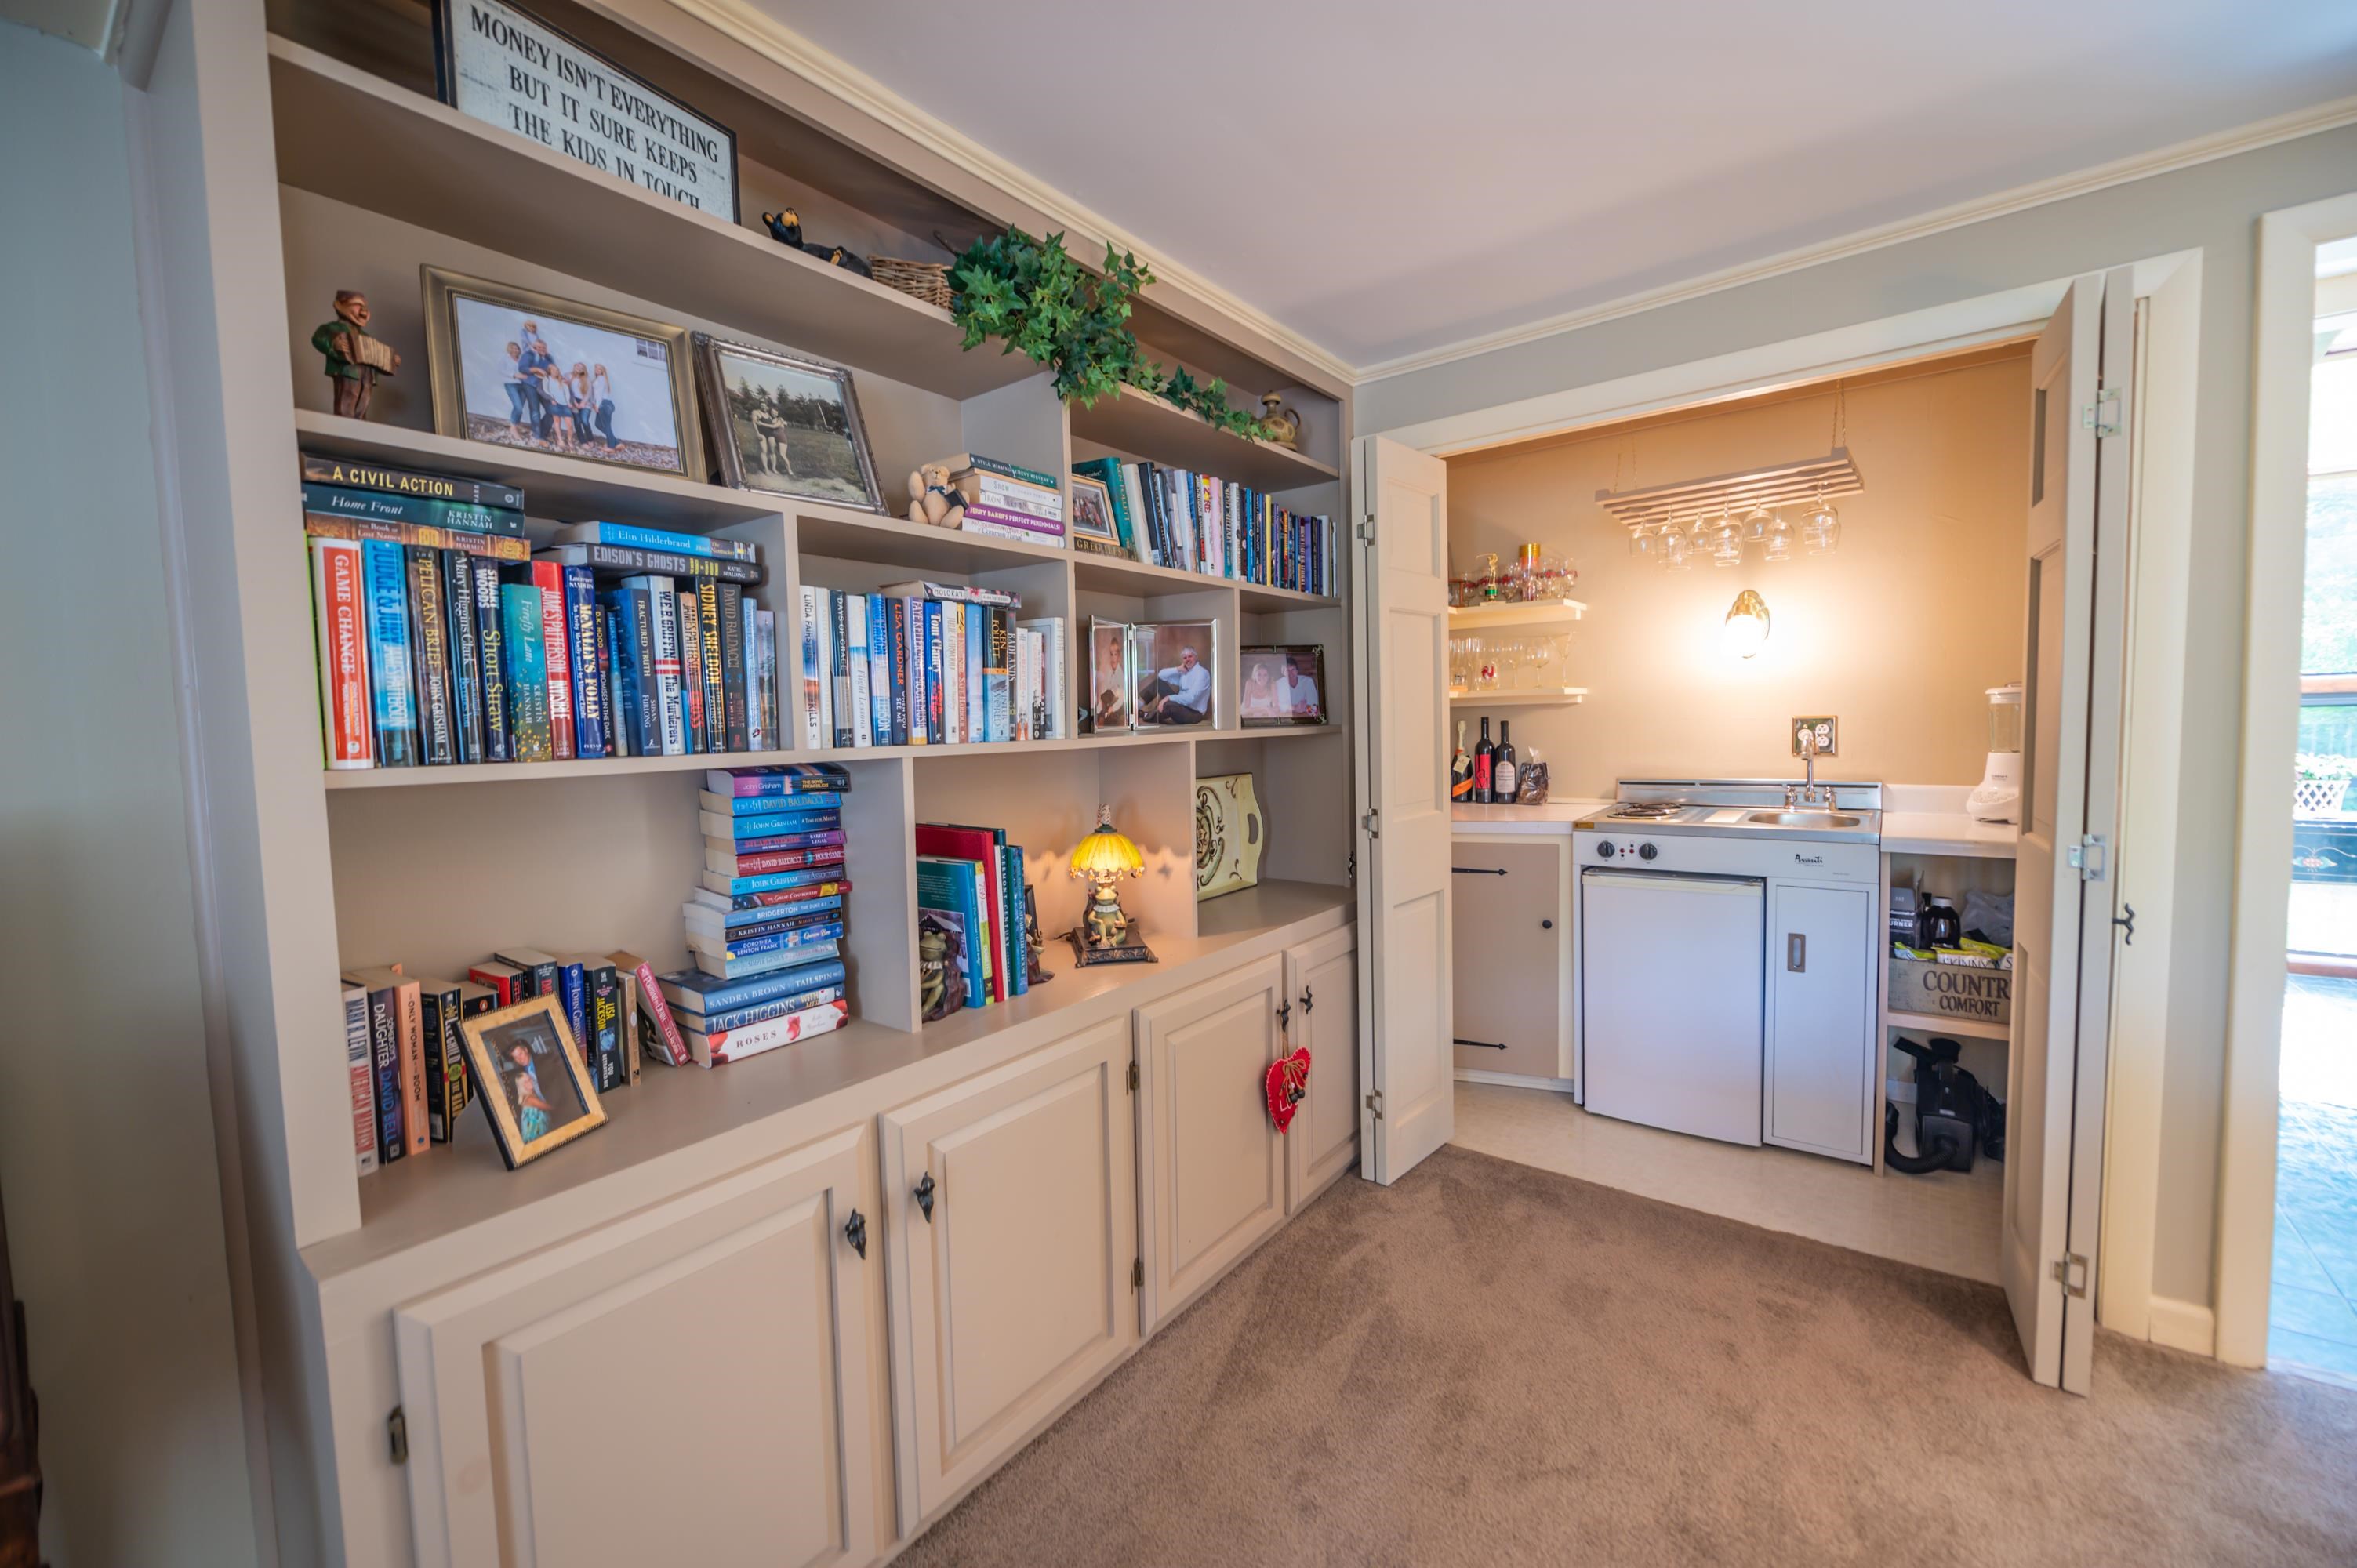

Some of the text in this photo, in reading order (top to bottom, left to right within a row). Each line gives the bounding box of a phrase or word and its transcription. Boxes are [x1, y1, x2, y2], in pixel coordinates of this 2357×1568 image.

[470, 6, 718, 163] MONEY ISN'T EVERYTHING
[509, 64, 698, 183] BUT IT SURE KEEPS
[509, 103, 700, 209] THE KIDS IN TOUCH
[332, 466, 453, 496] A CIVIL ACTION
[332, 495, 403, 516] Home Front
[447, 517, 492, 530] HANNAH
[449, 510, 492, 523] KRISTIN
[970, 507, 1060, 531] JERRY BAKER'S PERFECT PERENNIALS!
[618, 530, 637, 541] Elin
[640, 532, 690, 549] Hilderbrand
[594, 546, 643, 567] EDISON'S
[647, 554, 685, 572] GHOSTS
[335, 554, 351, 602] GAME
[373, 545, 405, 645] JUDGE & JURY
[476, 569, 489, 608] WOODS
[488, 569, 499, 609] STUART
[934, 588, 963, 597] MOLOKA'I
[419, 559, 441, 668] PELICAN BRIEF
[453, 556, 475, 665] Mary Higgins Clark
[700, 583, 717, 626] SIDNEY
[337, 606, 354, 673] CHANGE
[519, 600, 535, 663] Firefly Lane
[638, 601, 651, 677] FRACTURED TRUTH
[662, 619, 676, 659] GRIFFIN
[724, 588, 739, 668] DAVID BALDACCI
[931, 614, 941, 636] Tom
[992, 619, 1001, 659] FOLLETT
[541, 587, 571, 720] JAMES PATTERSON INVISIBLE
[580, 604, 600, 720] McNALLY'S FOLLY
[704, 630, 721, 684] SHELDON
[928, 638, 942, 673] Clancy
[483, 630, 503, 731] Short Straw
[600, 671, 608, 701] PROMISES
[386, 677, 408, 728] PATTERSON
[430, 675, 446, 743] JOHN GRISHAM
[523, 684, 532, 724] HANNAH
[534, 684, 543, 723] KRISTIN
[642, 695, 651, 728] FURLONG
[665, 675, 681, 745] The Murderers
[691, 691, 704, 728] CROSS
[806, 702, 817, 728] KILLS
[897, 712, 902, 723] ME
[763, 797, 823, 809] DAVID BALDACCI
[762, 856, 802, 867] DAVID BALDACCI
[751, 877, 798, 889] JOHN GRISHAM
[739, 921, 794, 936] KRISTIN HANNAH
[757, 906, 798, 919] BRIDGERTON
[737, 947, 760, 956] BENTON
[743, 939, 772, 949] DOROTHEA
[571, 988, 581, 1011] JOHN
[709, 972, 833, 1010] SANDRA BROWN TAILSPIN
[1923, 971, 2012, 1000] COUNTR
[597, 997, 606, 1031] JACKSON
[605, 1002, 615, 1020] LISA
[713, 1014, 742, 1033] JACK
[745, 999, 795, 1022] HIGGINS
[1939, 996, 1999, 1017] COMFORT
[345, 998, 372, 1110] MARK LEVIN AMERICAN
[387, 1017, 397, 1062] SOMEBODY'S
[736, 1030, 778, 1048] ROSES
[373, 1004, 397, 1145] DAUGHTER DAVID BELL
